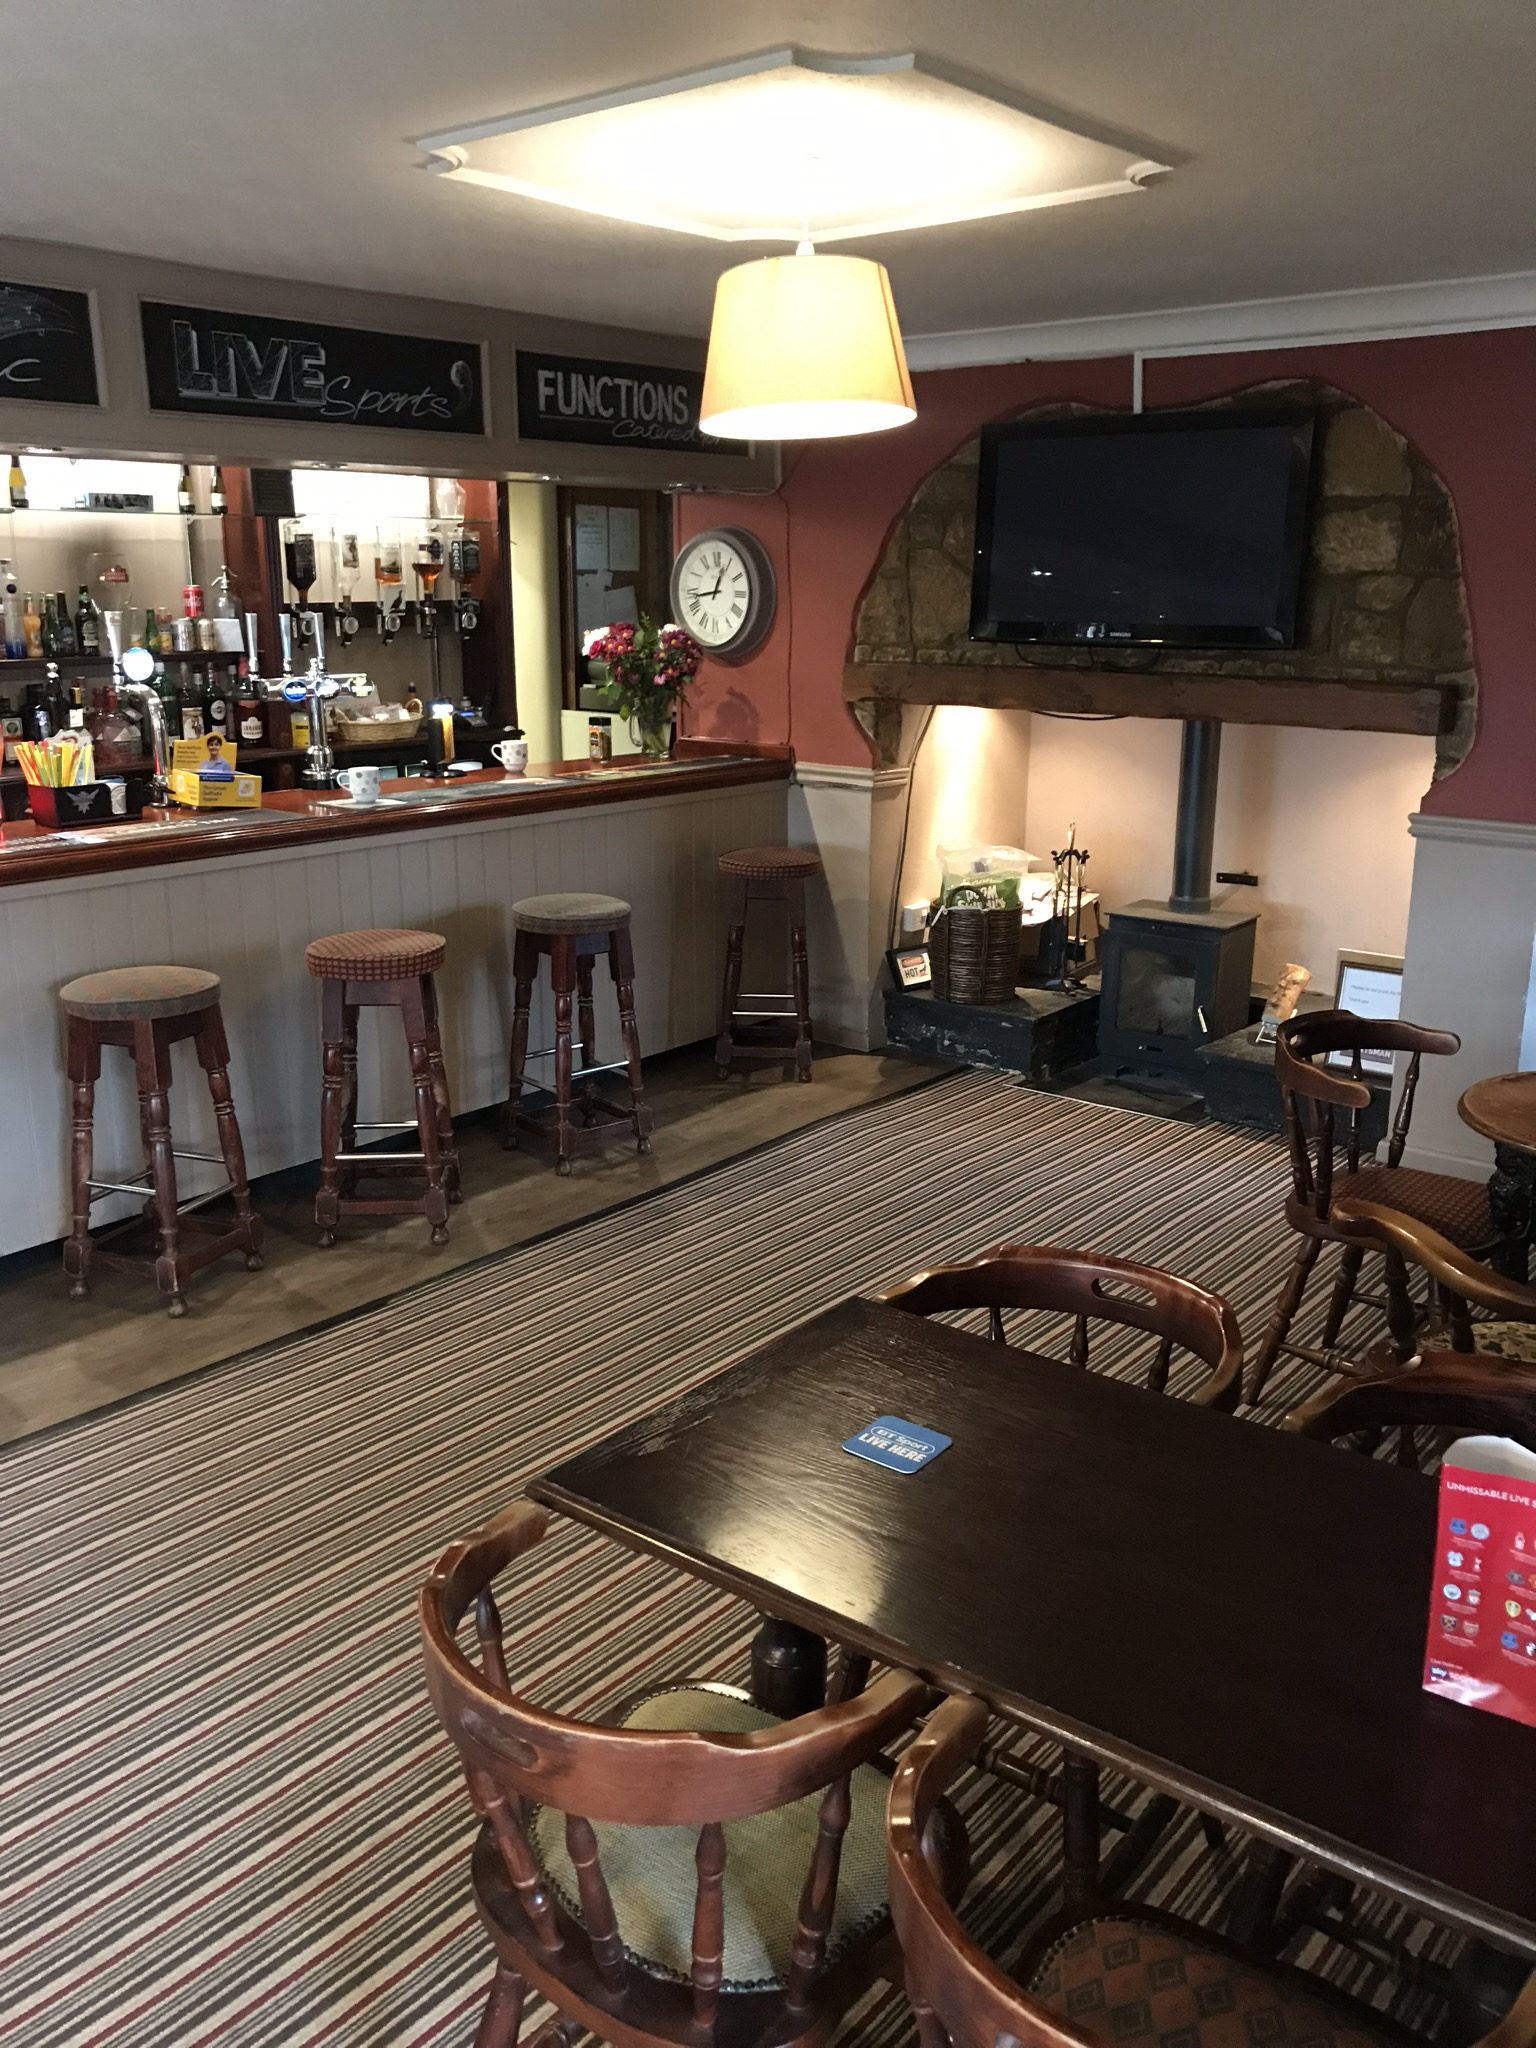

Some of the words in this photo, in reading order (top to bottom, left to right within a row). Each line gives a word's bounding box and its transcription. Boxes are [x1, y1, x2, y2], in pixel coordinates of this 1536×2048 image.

[172, 319, 326, 406] LIVE
[320, 375, 453, 420] Sports
[537, 369, 689, 425] FUNCTIONS
[612, 419, 698, 442] Catered
[904, 967, 919, 979] HOT
[858, 1433, 889, 1450] LIVE
[887, 1444, 927, 1463] HERE
[877, 1429, 895, 1439] BT
[896, 1436, 929, 1452] Sport
[1446, 1481, 1507, 1501] UNMISSABLE
[1509, 1494, 1530, 1506] LIVE
